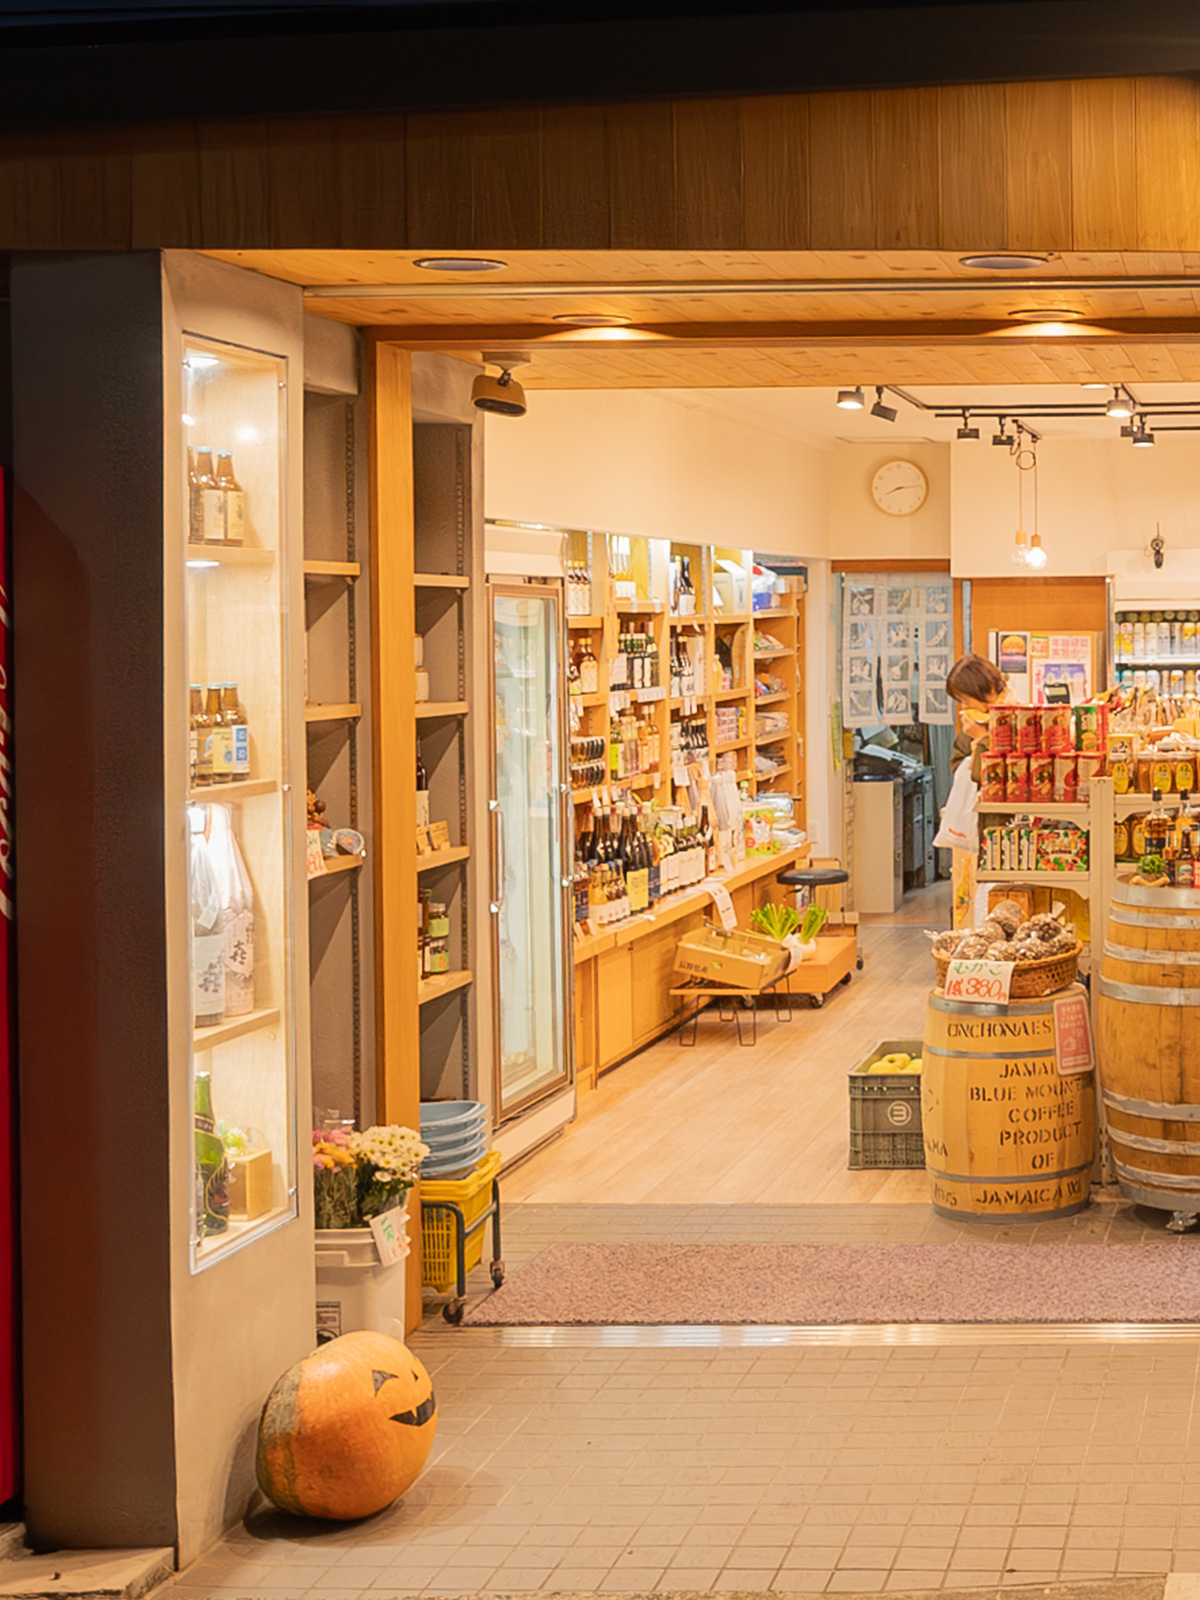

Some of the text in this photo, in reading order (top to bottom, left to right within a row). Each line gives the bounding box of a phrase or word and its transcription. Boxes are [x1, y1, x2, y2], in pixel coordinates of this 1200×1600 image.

[970, 1086, 1017, 1102] BLUE
[1008, 1101, 1074, 1123] COFFEE
[1000, 1121, 1082, 1146] PRODUCT
[1032, 1152, 1055, 1169] OF
[975, 1181, 1063, 1205] JAMAICA
